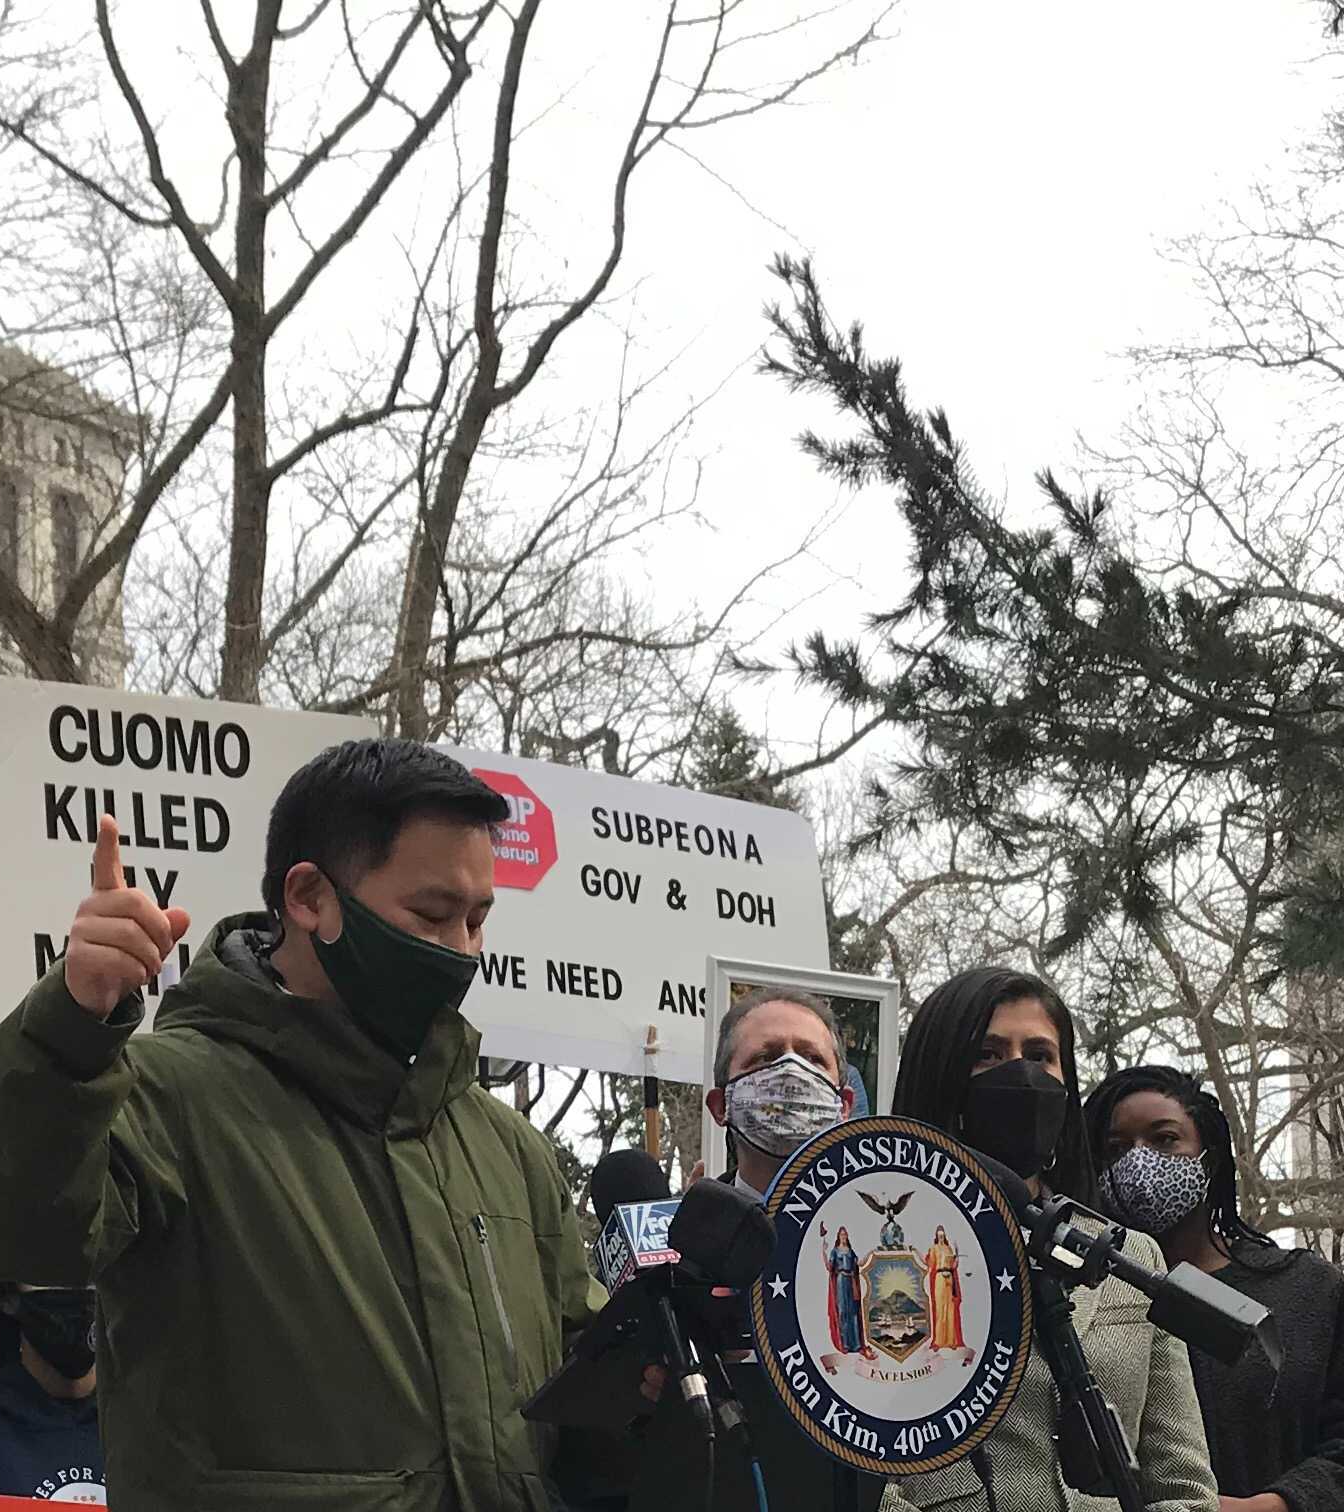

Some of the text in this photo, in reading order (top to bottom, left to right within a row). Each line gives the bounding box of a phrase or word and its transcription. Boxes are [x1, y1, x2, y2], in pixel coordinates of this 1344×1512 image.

[49, 704, 250, 778] CUOMO
[580, 864, 776, 928] GOV & DOH
[481, 951, 527, 990] WE
[546, 958, 622, 1001] NEED
[782, 1136, 994, 1230] NYS ASSEMBLY
[778, 1339, 825, 1410] Ron
[893, 1421, 941, 1457] 40th
[943, 1339, 1014, 1441] District
[57, 1467, 94, 1483] FOR
